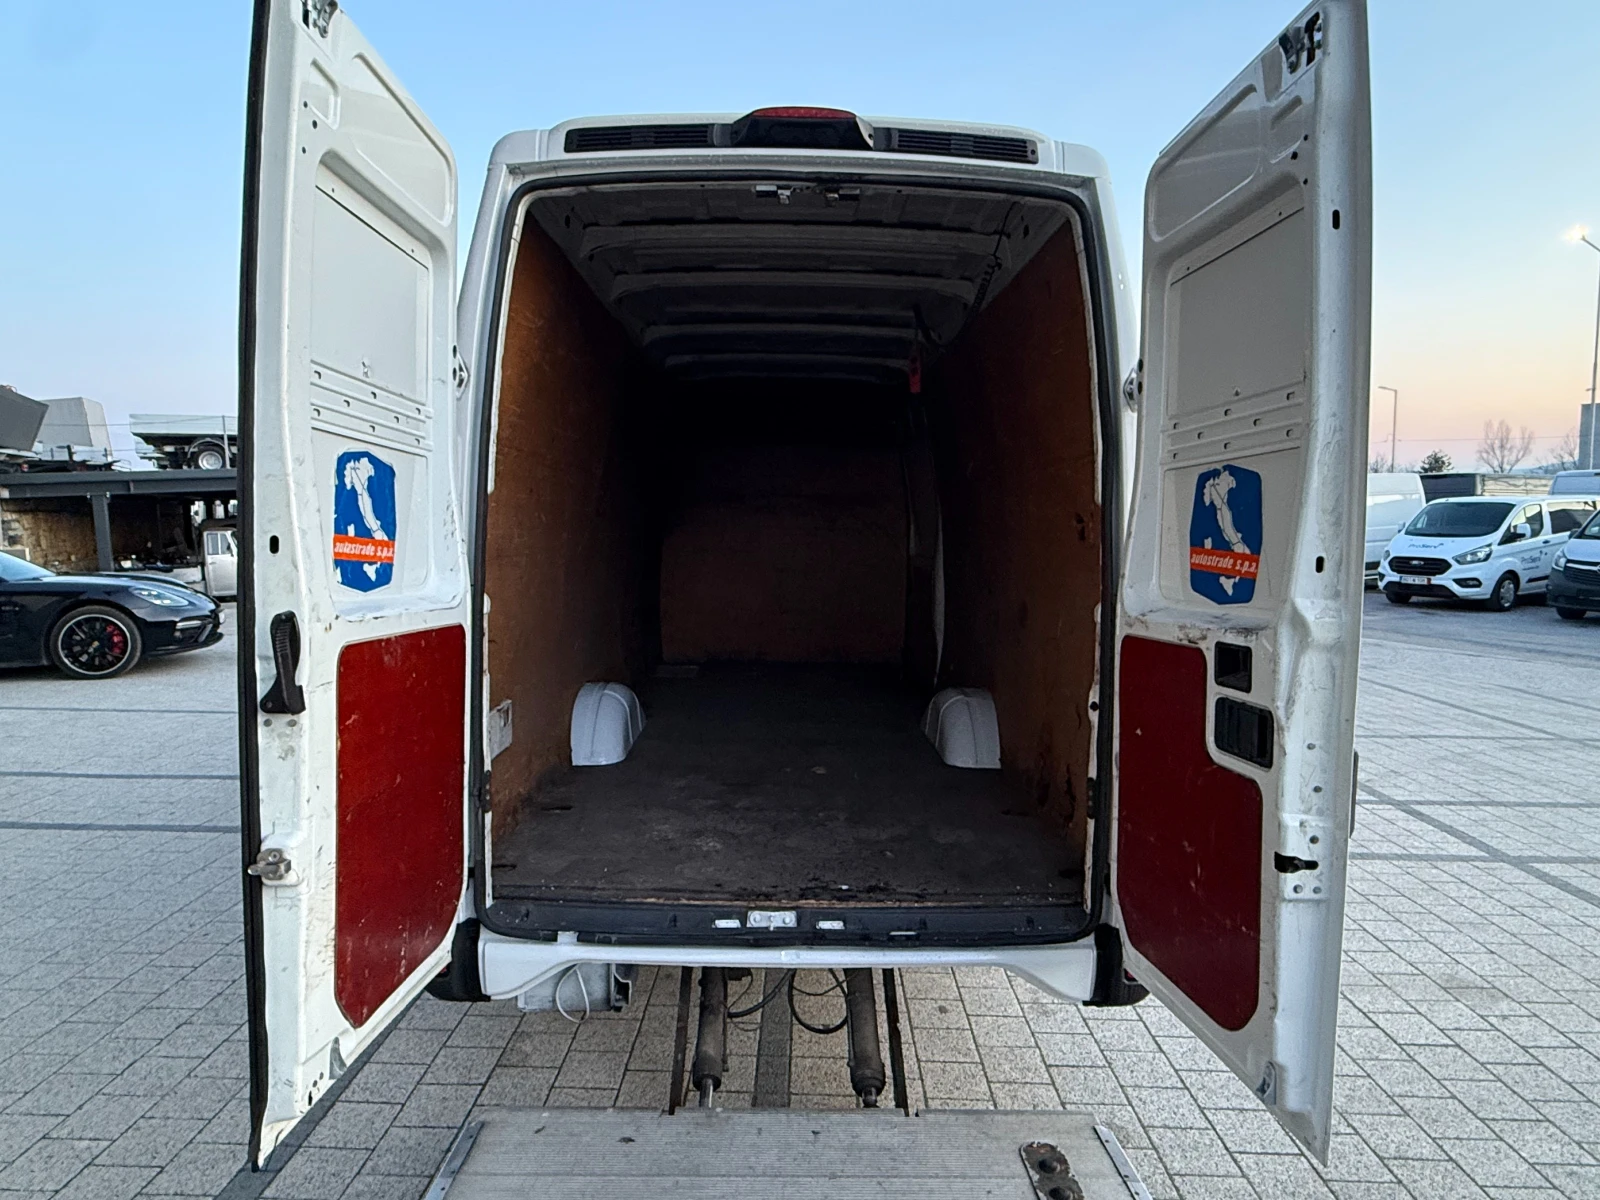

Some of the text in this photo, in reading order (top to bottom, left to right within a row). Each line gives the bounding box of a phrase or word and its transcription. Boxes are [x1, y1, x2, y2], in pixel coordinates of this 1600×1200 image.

[334, 541, 376, 556] autostrade
[1190, 553, 1258, 574] autostrade s.p.a.
